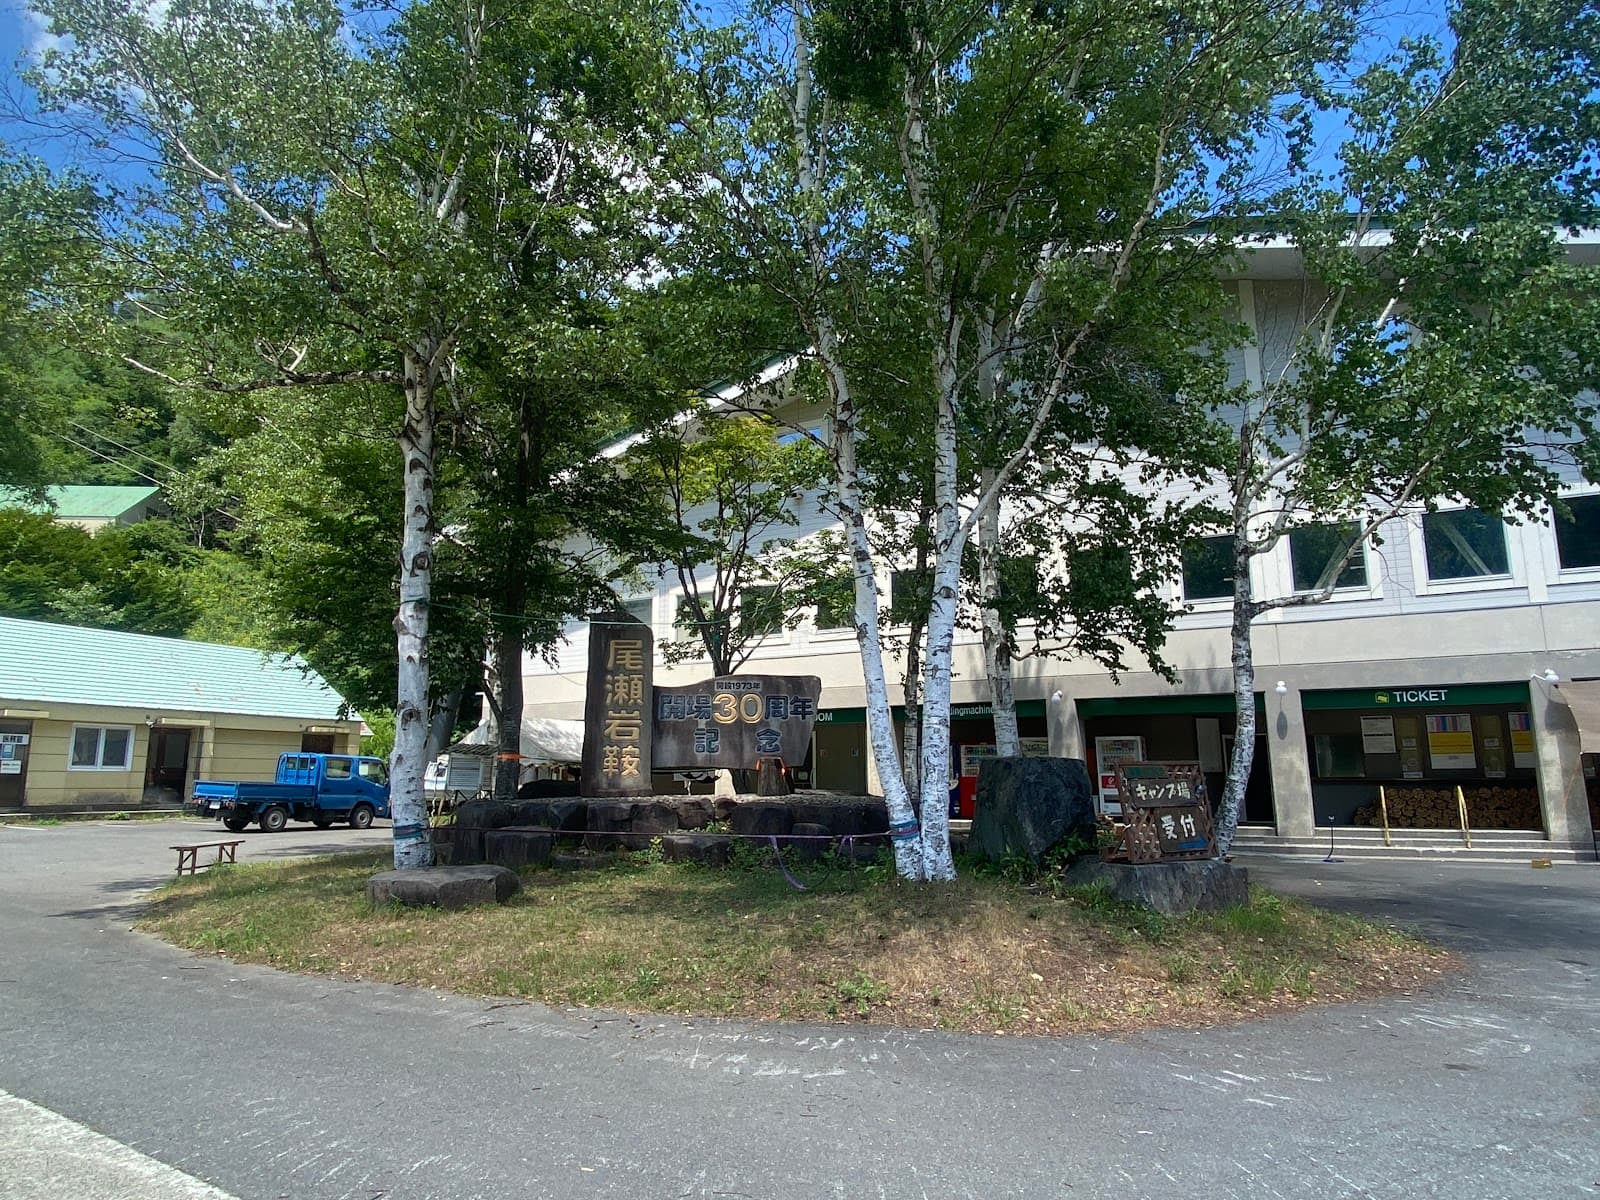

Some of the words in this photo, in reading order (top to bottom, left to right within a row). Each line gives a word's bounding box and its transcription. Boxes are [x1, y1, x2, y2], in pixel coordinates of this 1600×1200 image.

[658, 692, 814, 724] 開場30周年
[1393, 689, 1448, 703] TICKET
[602, 639, 644, 779] 尾瀬岩鞍
[815, 712, 833, 721] OM
[694, 728, 781, 753] 記念
[1135, 781, 1191, 801] キャンプ場
[1161, 814, 1196, 840] 受付
